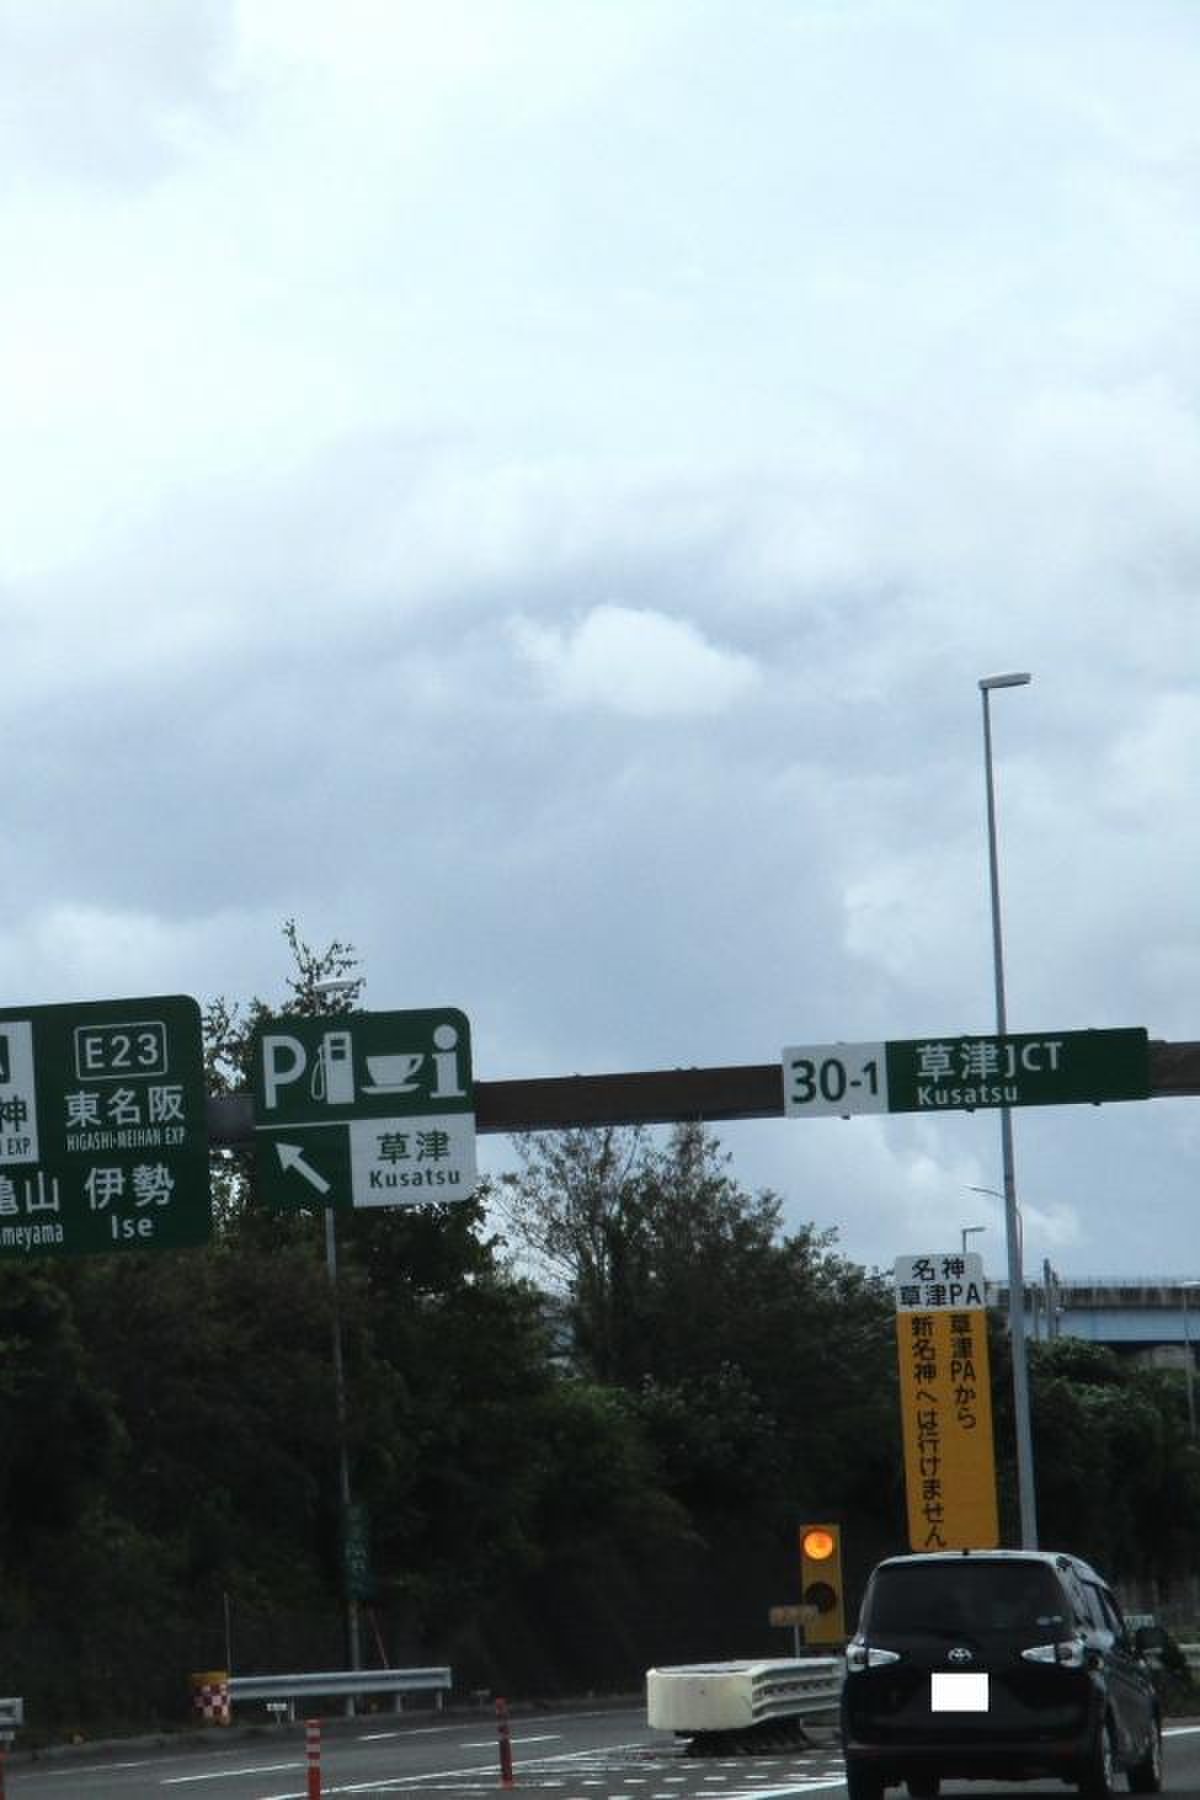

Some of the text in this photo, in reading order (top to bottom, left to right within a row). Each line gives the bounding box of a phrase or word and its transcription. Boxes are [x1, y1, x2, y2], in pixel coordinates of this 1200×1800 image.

[85, 1033, 159, 1069] E23
[916, 1040, 1063, 1082] 草津JCT
[790, 1057, 879, 1104] 30-1
[64, 1085, 185, 1128] 東名阪
[917, 1084, 1019, 1106] Kusatsu
[7, 1137, 31, 1156] EXP
[66, 1126, 186, 1151] HIGASHI-MEIHAN EXP
[376, 1130, 450, 1165] 草津
[84, 1162, 175, 1210] 伊勢
[370, 1169, 461, 1189] Kusatsu
[110, 1215, 154, 1240] Ise
[911, 1258, 965, 1281] 名神
[900, 1283, 982, 1307] 草津PA
